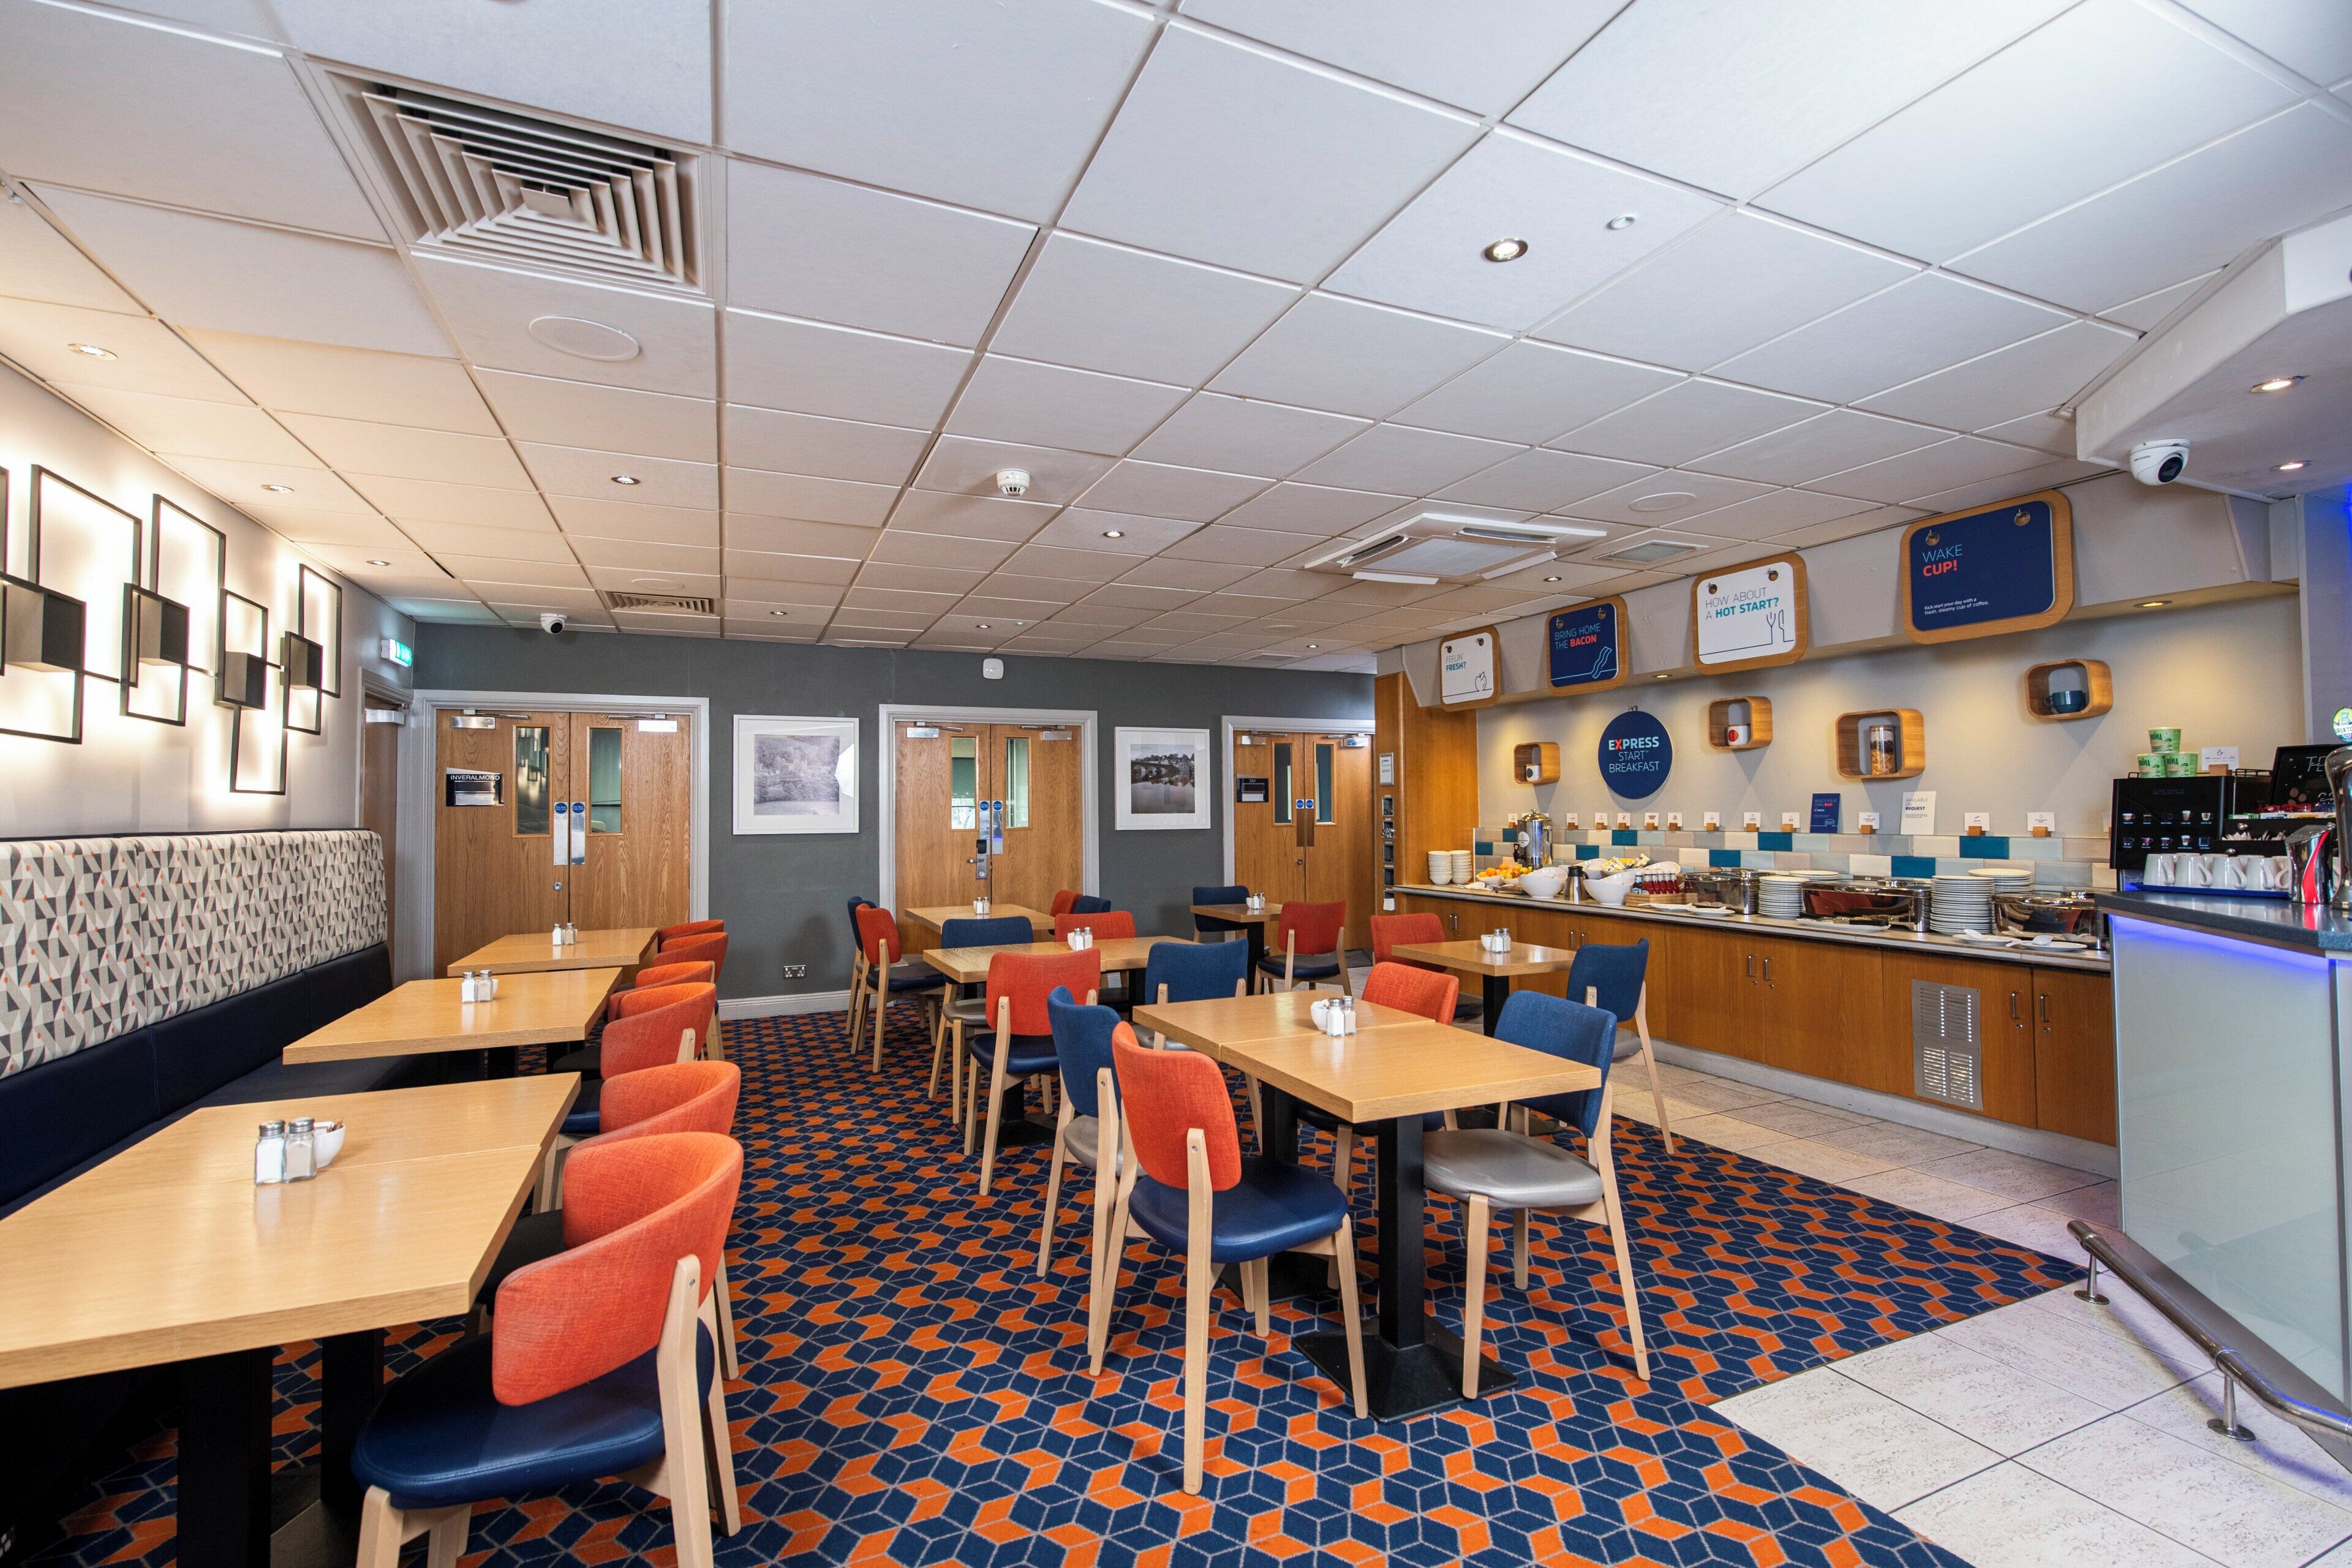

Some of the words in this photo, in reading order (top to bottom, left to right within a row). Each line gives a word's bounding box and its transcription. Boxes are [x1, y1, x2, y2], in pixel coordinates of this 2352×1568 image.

[1923, 544, 1962, 562] WAKE
[1923, 560, 1957, 576] CUP!
[1706, 595, 1729, 608] HOW
[1733, 587, 1767, 603] ABOUT
[1706, 611, 1713, 620] A
[1716, 606, 1736, 618] HOT
[1740, 597, 1779, 614] START?
[1555, 628, 1577, 640] BRING
[1579, 623, 1601, 635] HOME
[1555, 640, 1568, 649] THE
[1570, 635, 1597, 647] BACON
[1446, 662, 1466, 671] FRESH?
[1608, 736, 1660, 750] EXPRESS
[1609, 761, 1660, 773] BREAKFAST
